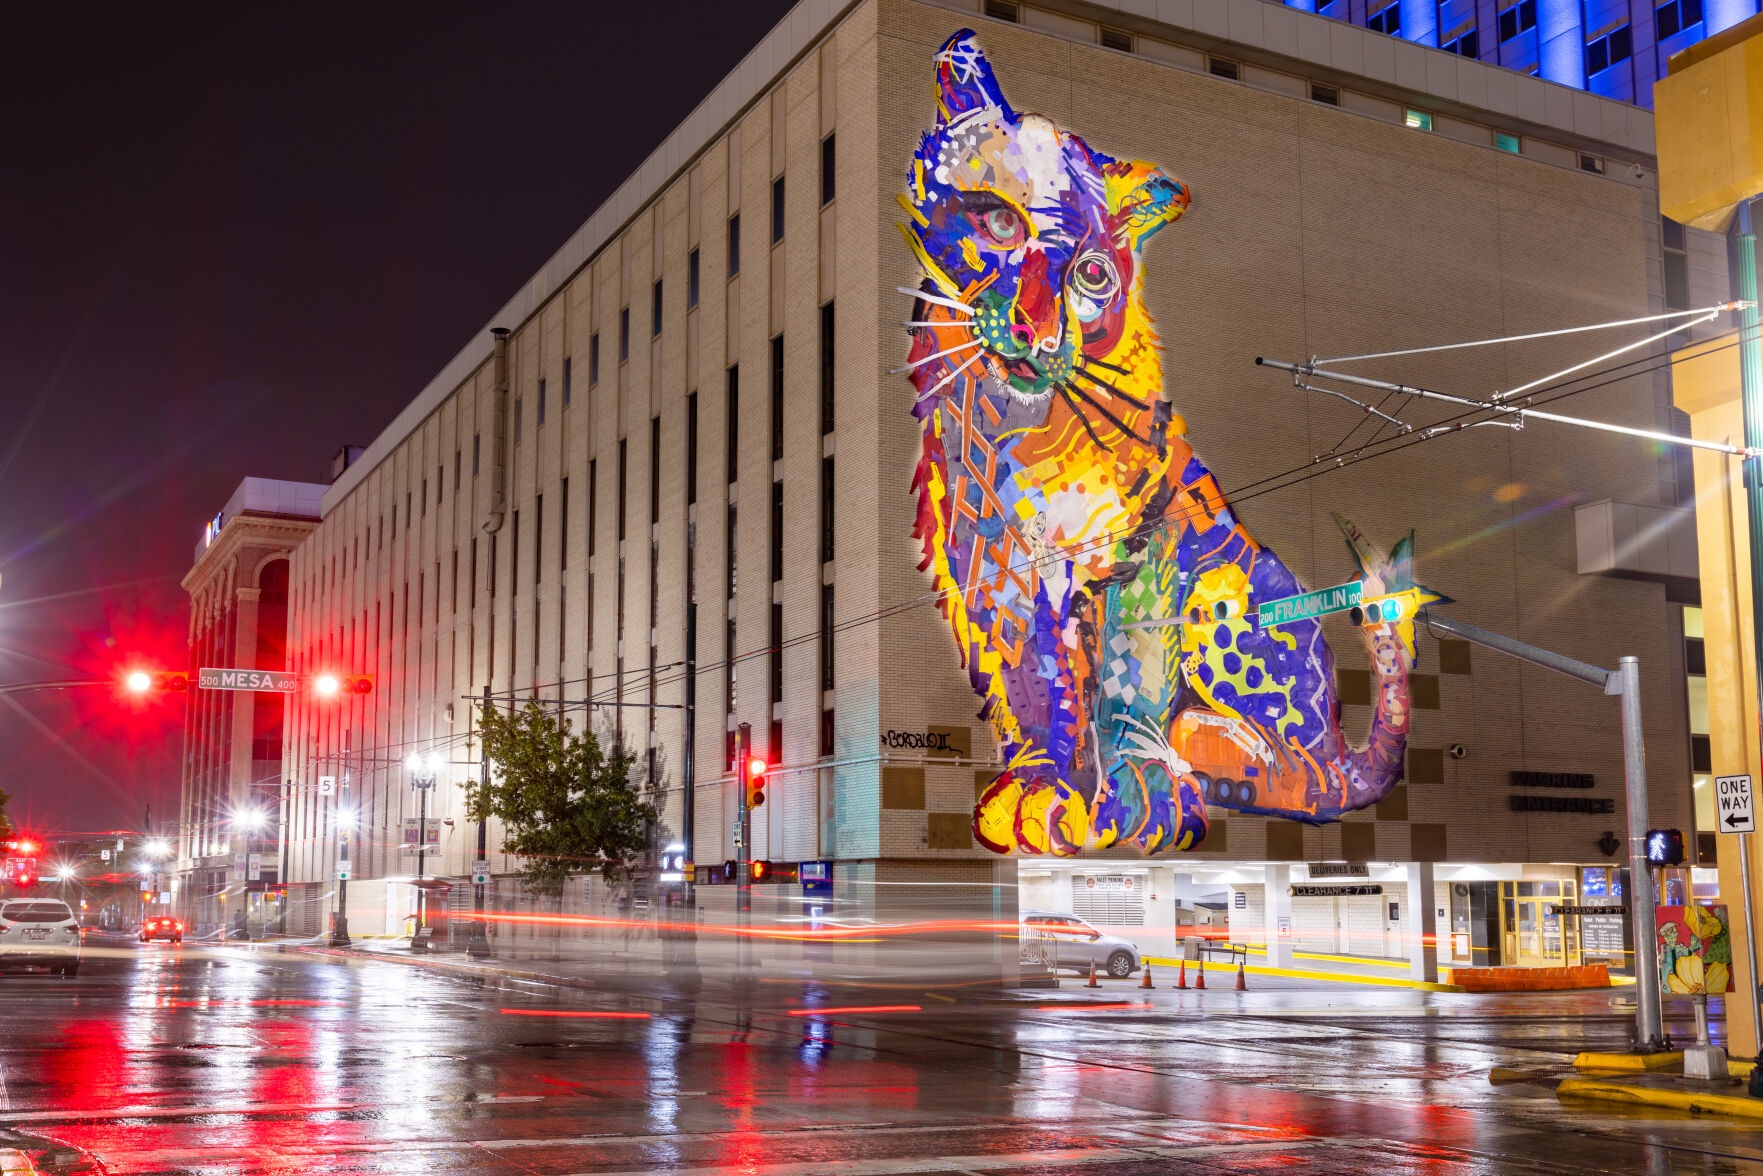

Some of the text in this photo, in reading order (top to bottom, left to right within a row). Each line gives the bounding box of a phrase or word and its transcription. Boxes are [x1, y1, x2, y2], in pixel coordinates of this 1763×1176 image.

[1260, 589, 1362, 625] 200 FRANKLIN 100
[201, 672, 295, 690] 500 MESA 400
[323, 780, 331, 792] 5
[1720, 780, 1748, 795] ONE
[1720, 795, 1749, 810] WAY
[1311, 865, 1366, 875] DELIVERIES ONLY
[1296, 886, 1351, 896] CLEARANCE
